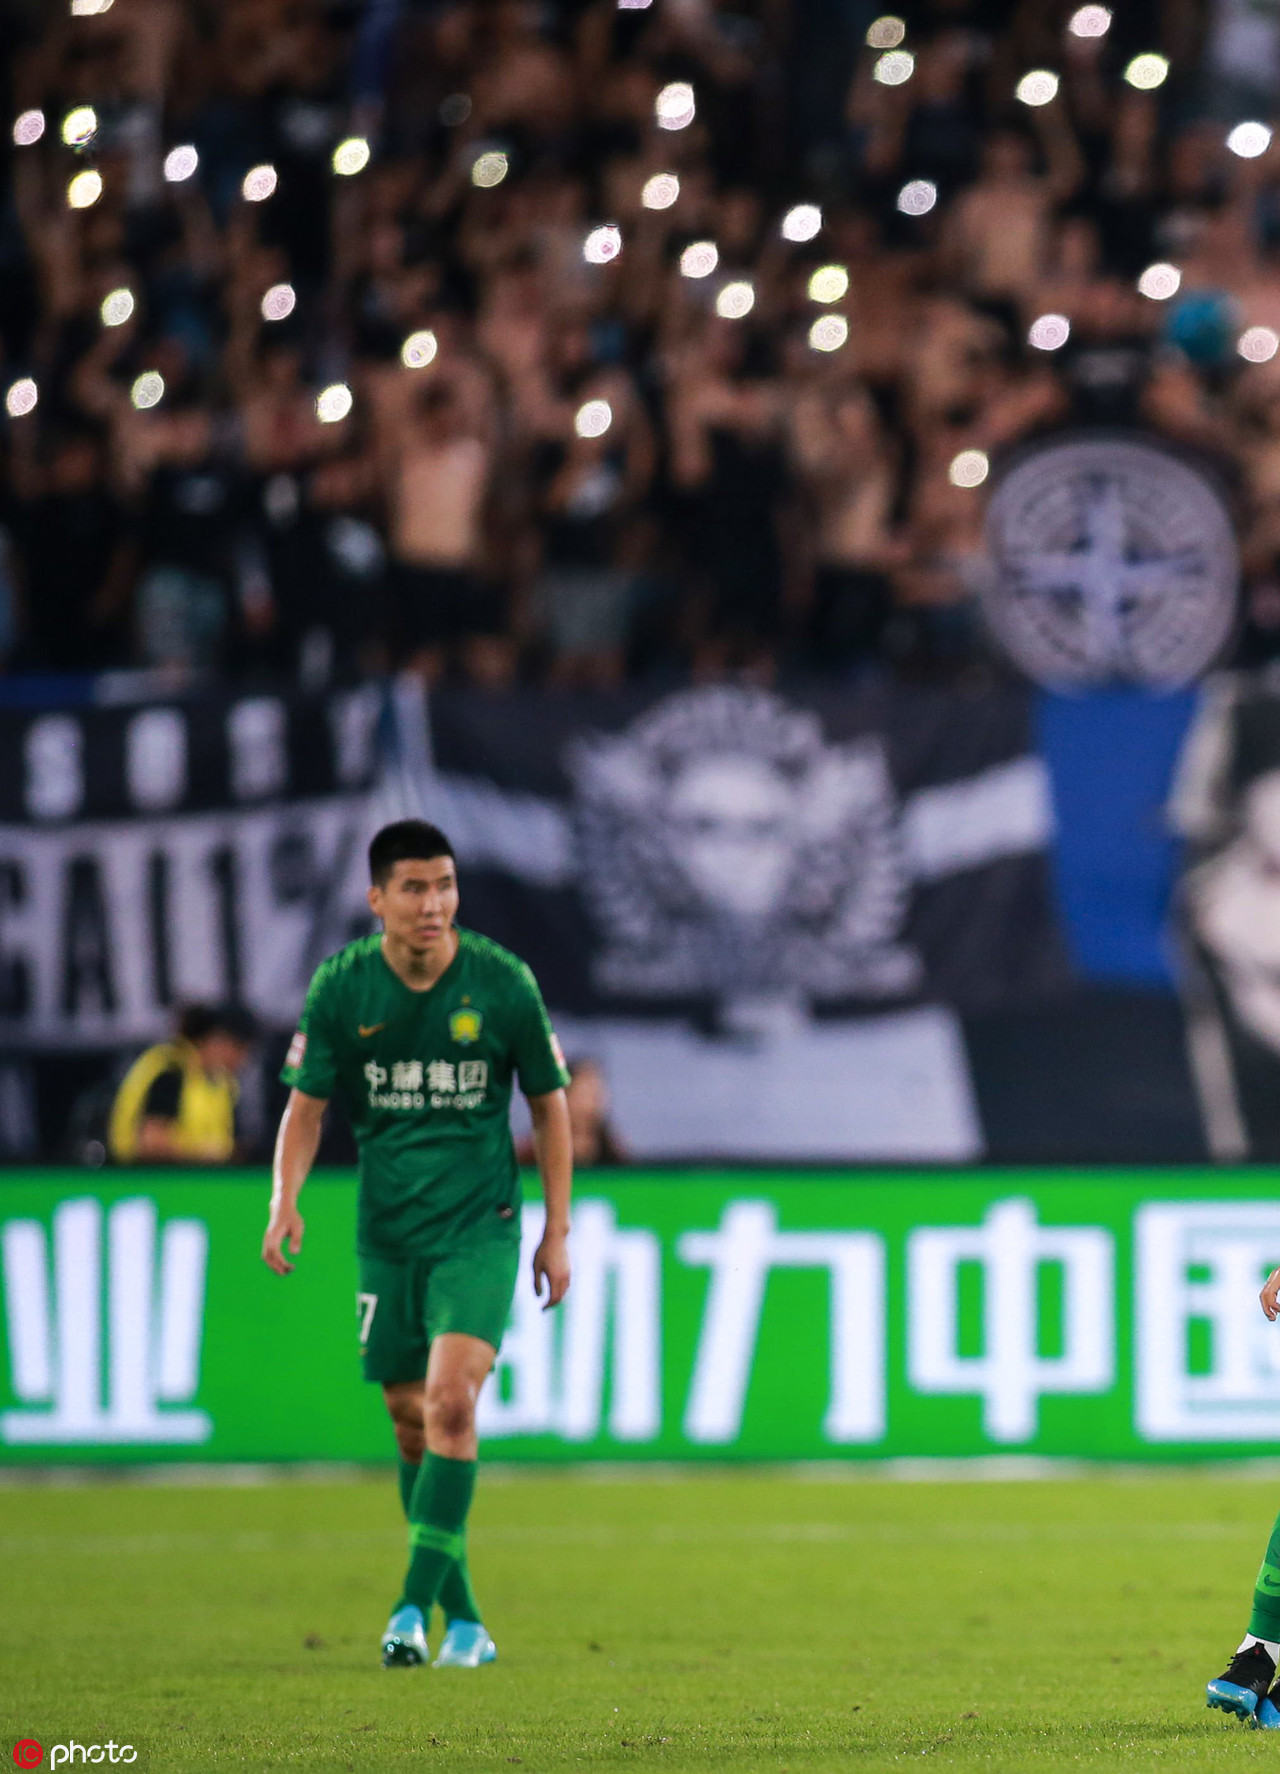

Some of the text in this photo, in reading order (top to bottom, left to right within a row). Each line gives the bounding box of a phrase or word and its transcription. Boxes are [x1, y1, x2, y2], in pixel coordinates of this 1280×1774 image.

[364, 1059, 488, 1092] 中赫集团
[0, 1198, 212, 1445] 业
